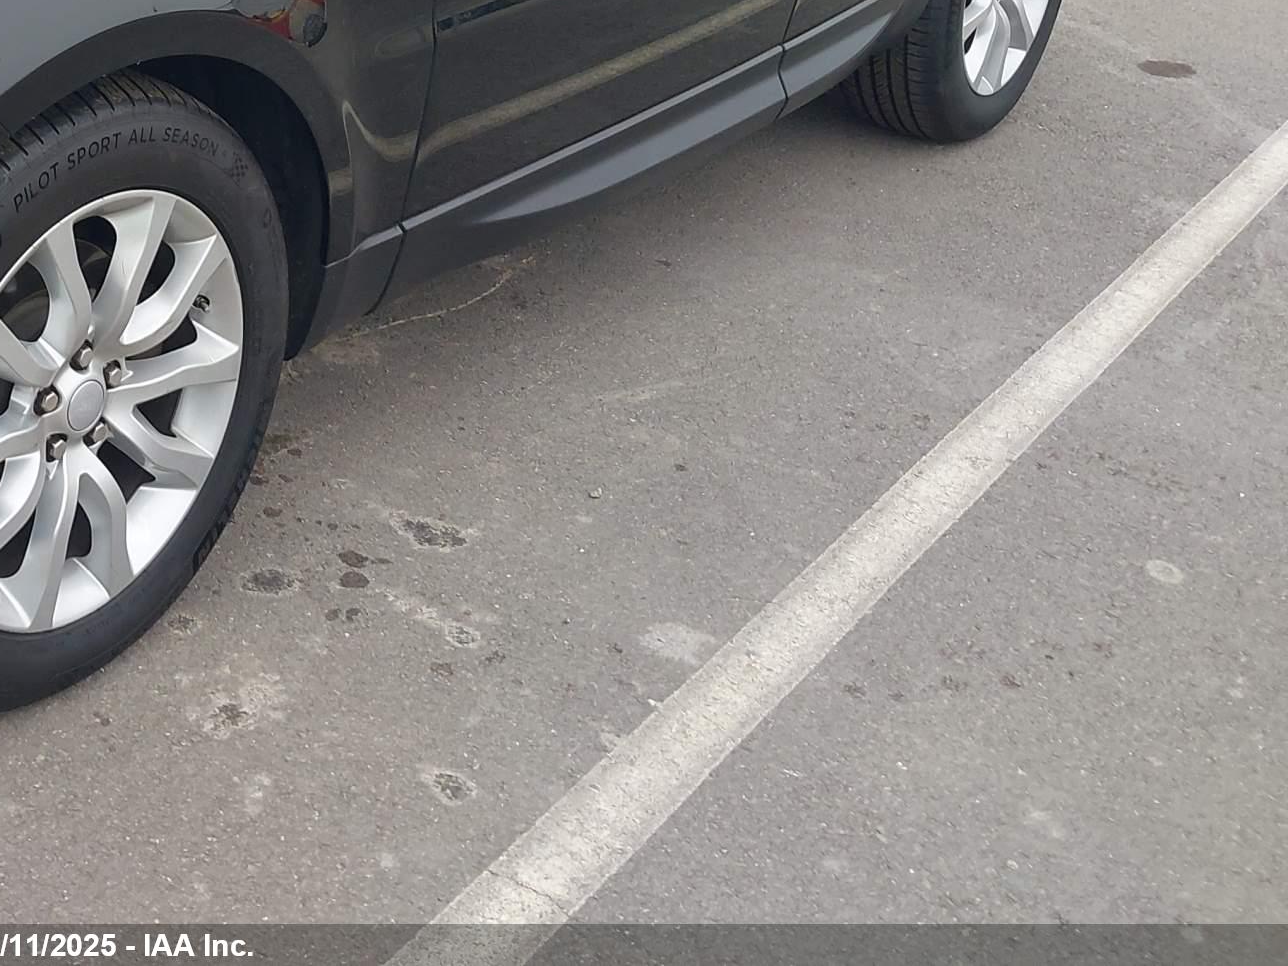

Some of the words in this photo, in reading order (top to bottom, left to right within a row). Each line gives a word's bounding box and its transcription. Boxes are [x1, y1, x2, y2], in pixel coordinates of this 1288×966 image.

[13, 162, 60, 213] PILOT
[67, 132, 121, 170] SPORT
[128, 126, 156, 145] ALL
[162, 126, 220, 157] SEASON
